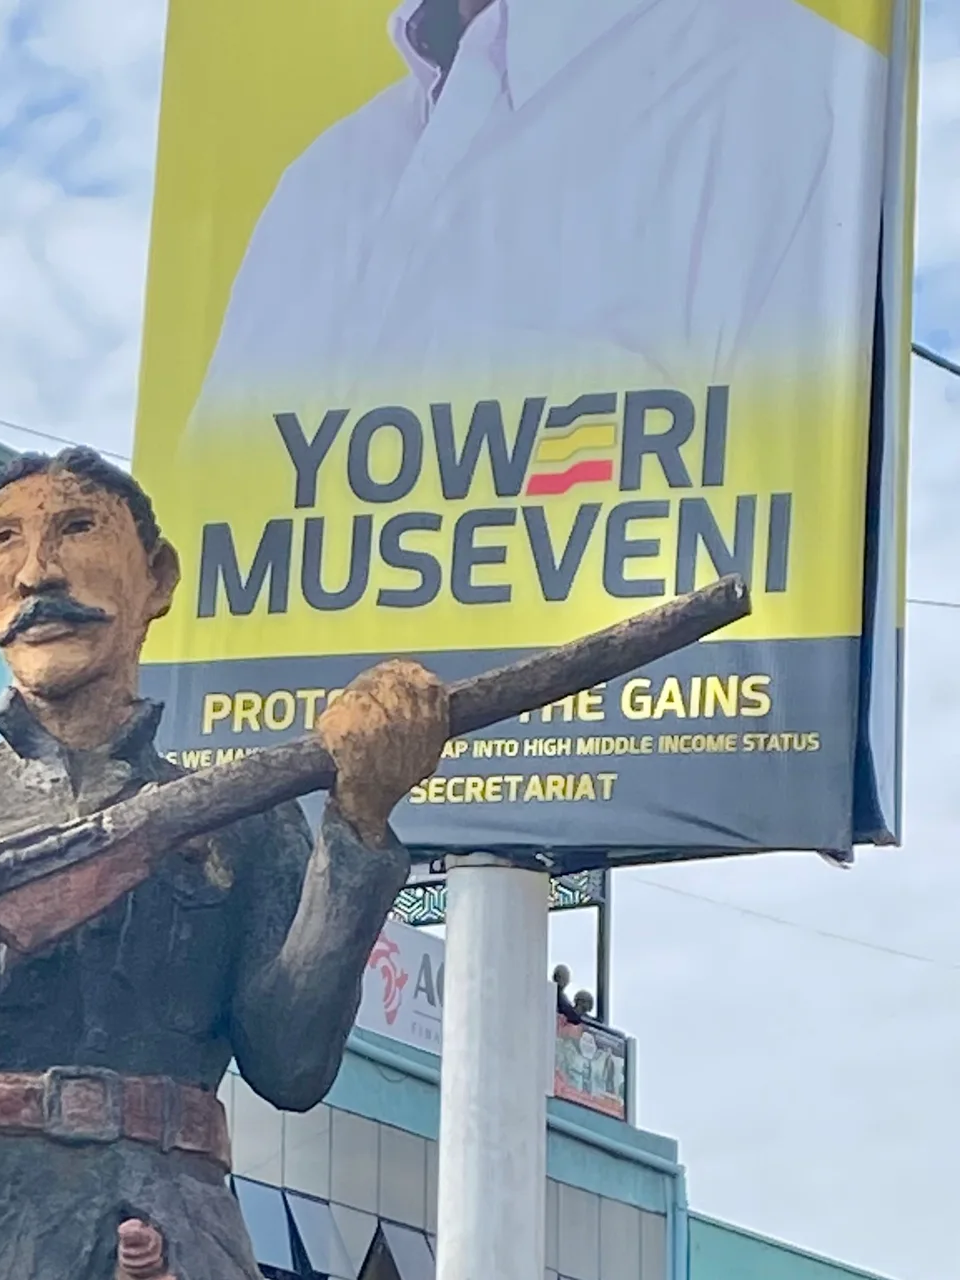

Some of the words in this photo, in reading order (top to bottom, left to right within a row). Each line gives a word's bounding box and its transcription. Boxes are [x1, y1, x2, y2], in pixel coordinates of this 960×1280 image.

[273, 385, 729, 508] YOWERI
[197, 492, 792, 618] MUSEVENI
[621, 675, 771, 721] GAINS
[182, 748, 212, 769] WE
[472, 739, 519, 758] INTO
[524, 737, 571, 757] HIGH
[576, 735, 653, 756] MIDDLE
[658, 733, 738, 754] INCOME
[742, 732, 820, 752] STATUS
[409, 773, 618, 804] SECRETARIAT
